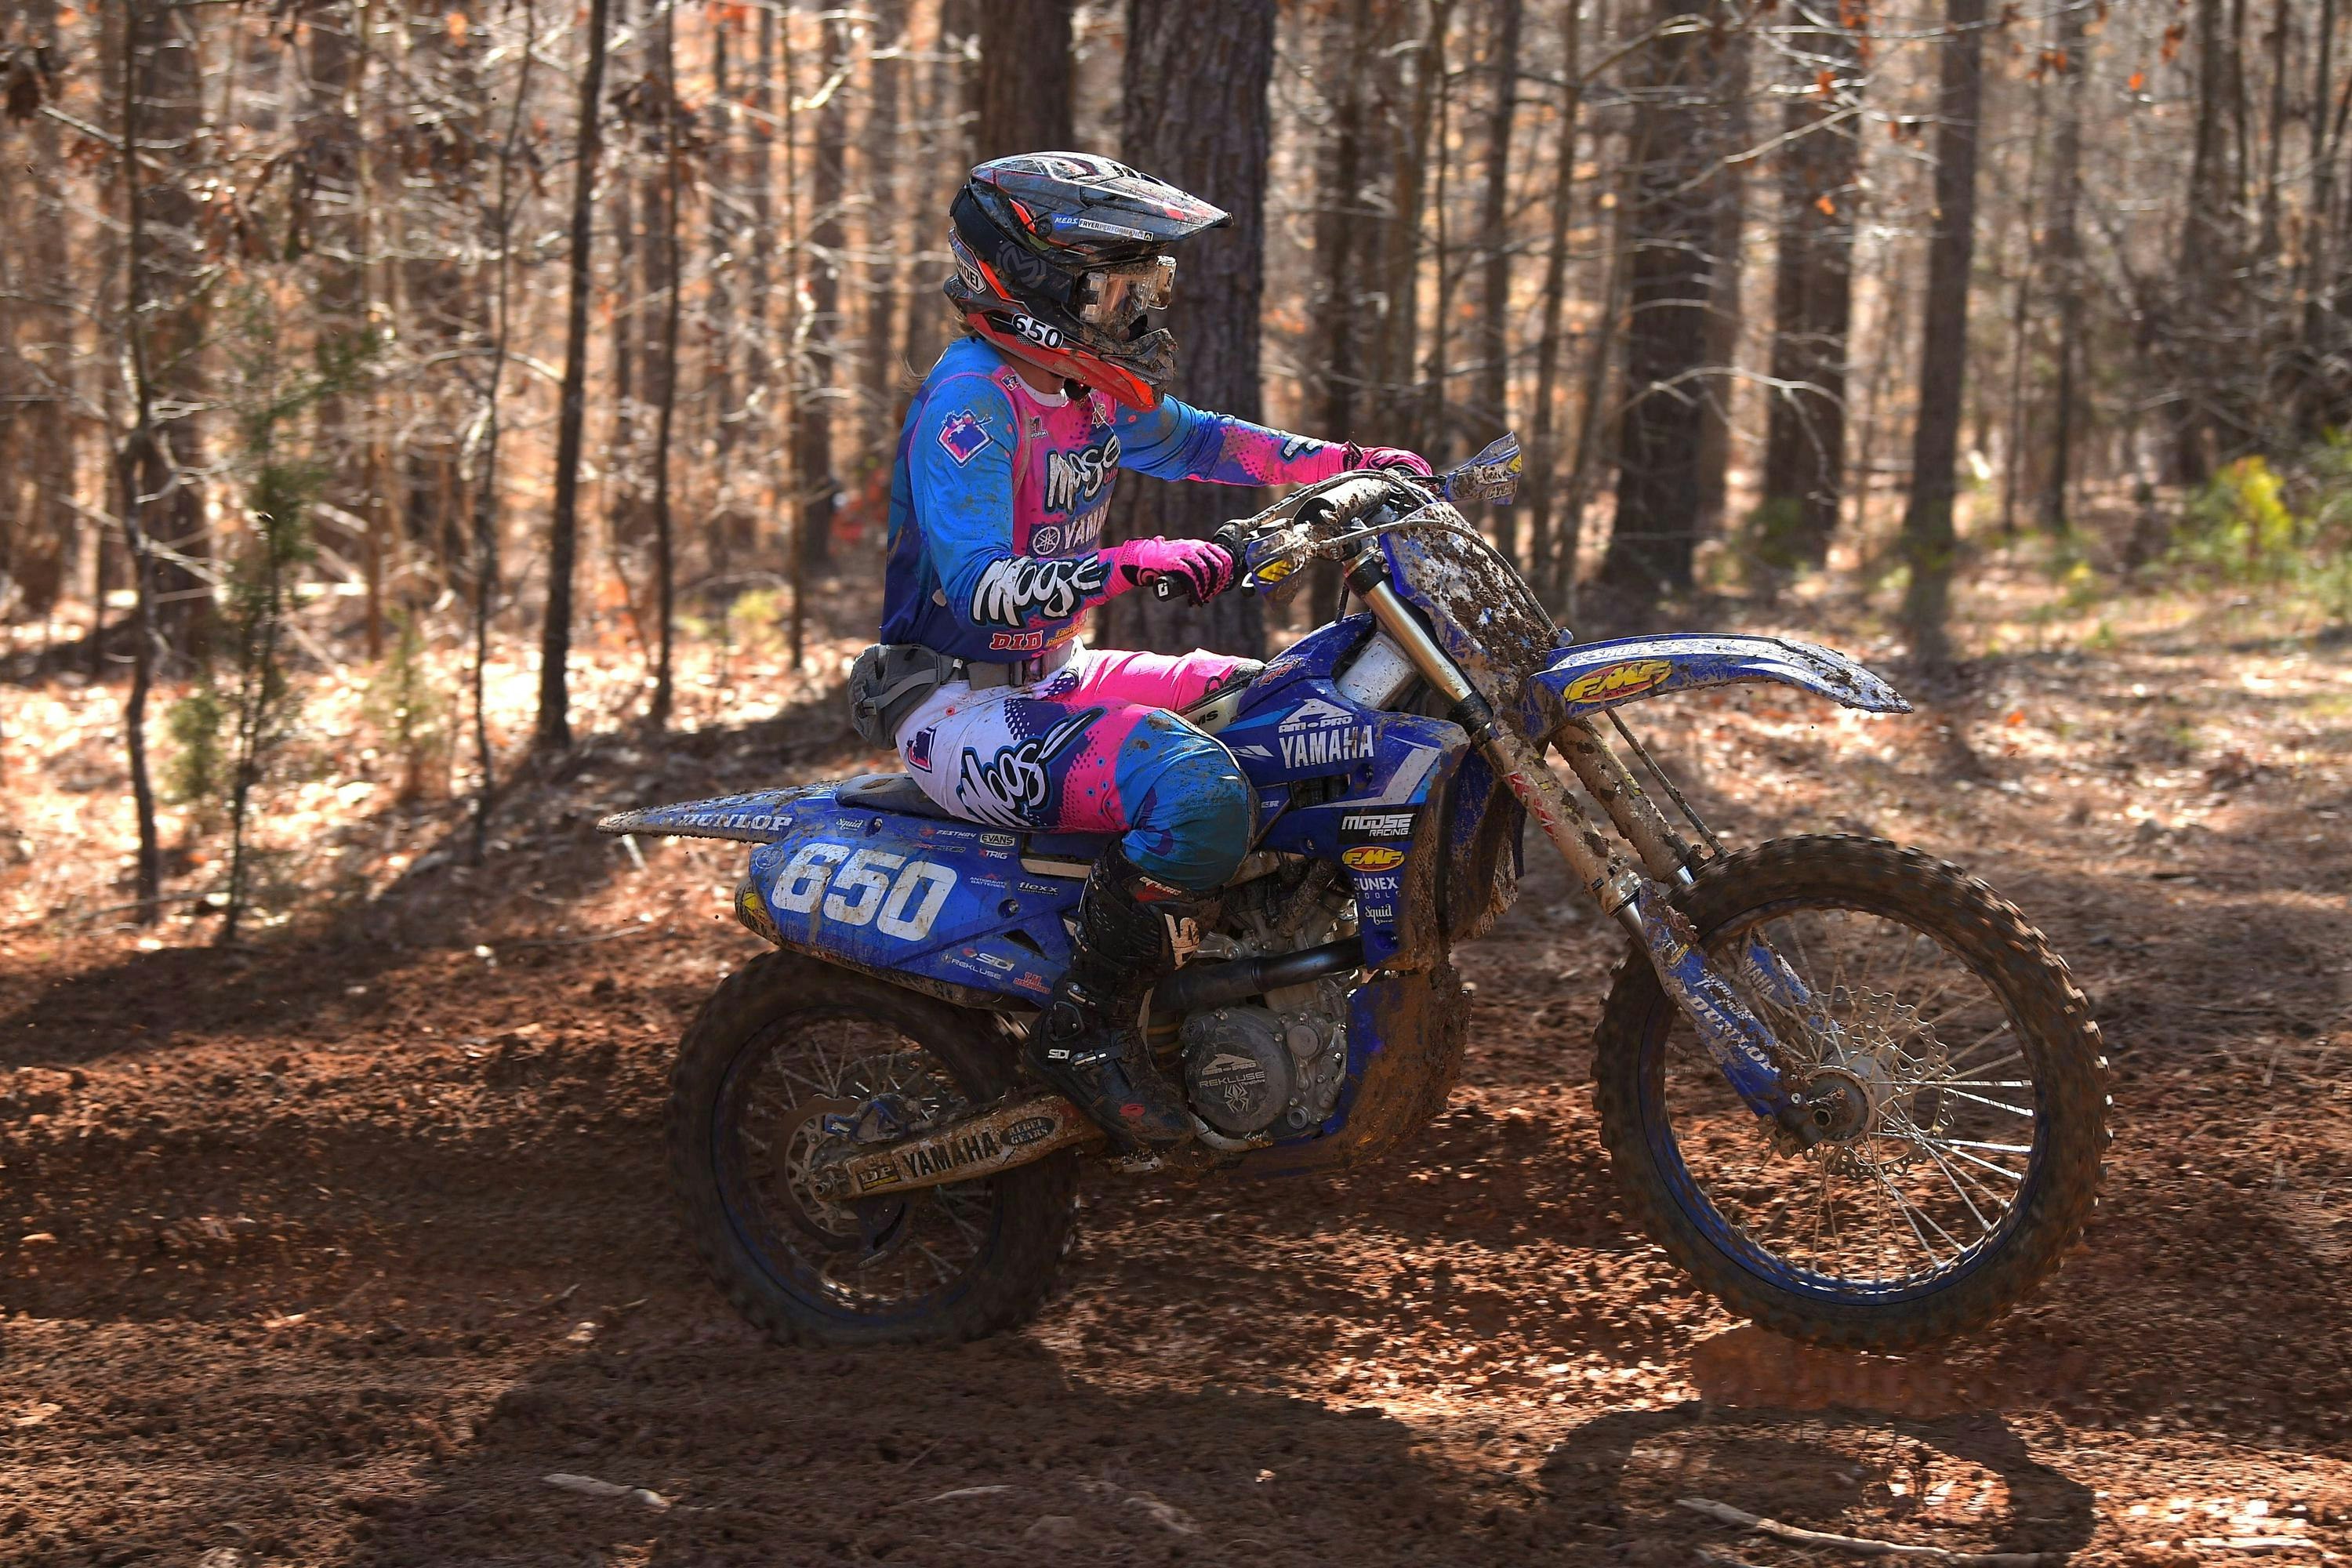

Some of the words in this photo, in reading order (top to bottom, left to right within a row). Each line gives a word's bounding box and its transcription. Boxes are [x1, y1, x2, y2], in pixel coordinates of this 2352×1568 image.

[956, 256, 979, 290] HOEI
[1013, 314, 1062, 348] 650
[1567, 660, 1671, 701] FMF
[1279, 724, 1374, 769] YAMAHA
[677, 814, 793, 831] DUNLOP
[836, 818, 863, 830] Squid
[1341, 813, 1416, 829] MOOSE
[982, 834, 1013, 844] EVANS
[1369, 828, 1410, 837] RACING
[1344, 849, 1403, 865] FMF
[771, 843, 957, 941] 650
[1019, 882, 1058, 892] flexx
[1365, 903, 1392, 925] Squid
[951, 958, 1002, 980] REKLUSE
[1199, 1071, 1265, 1088] REKLUSE
[902, 1131, 1000, 1178] YAMAHA
